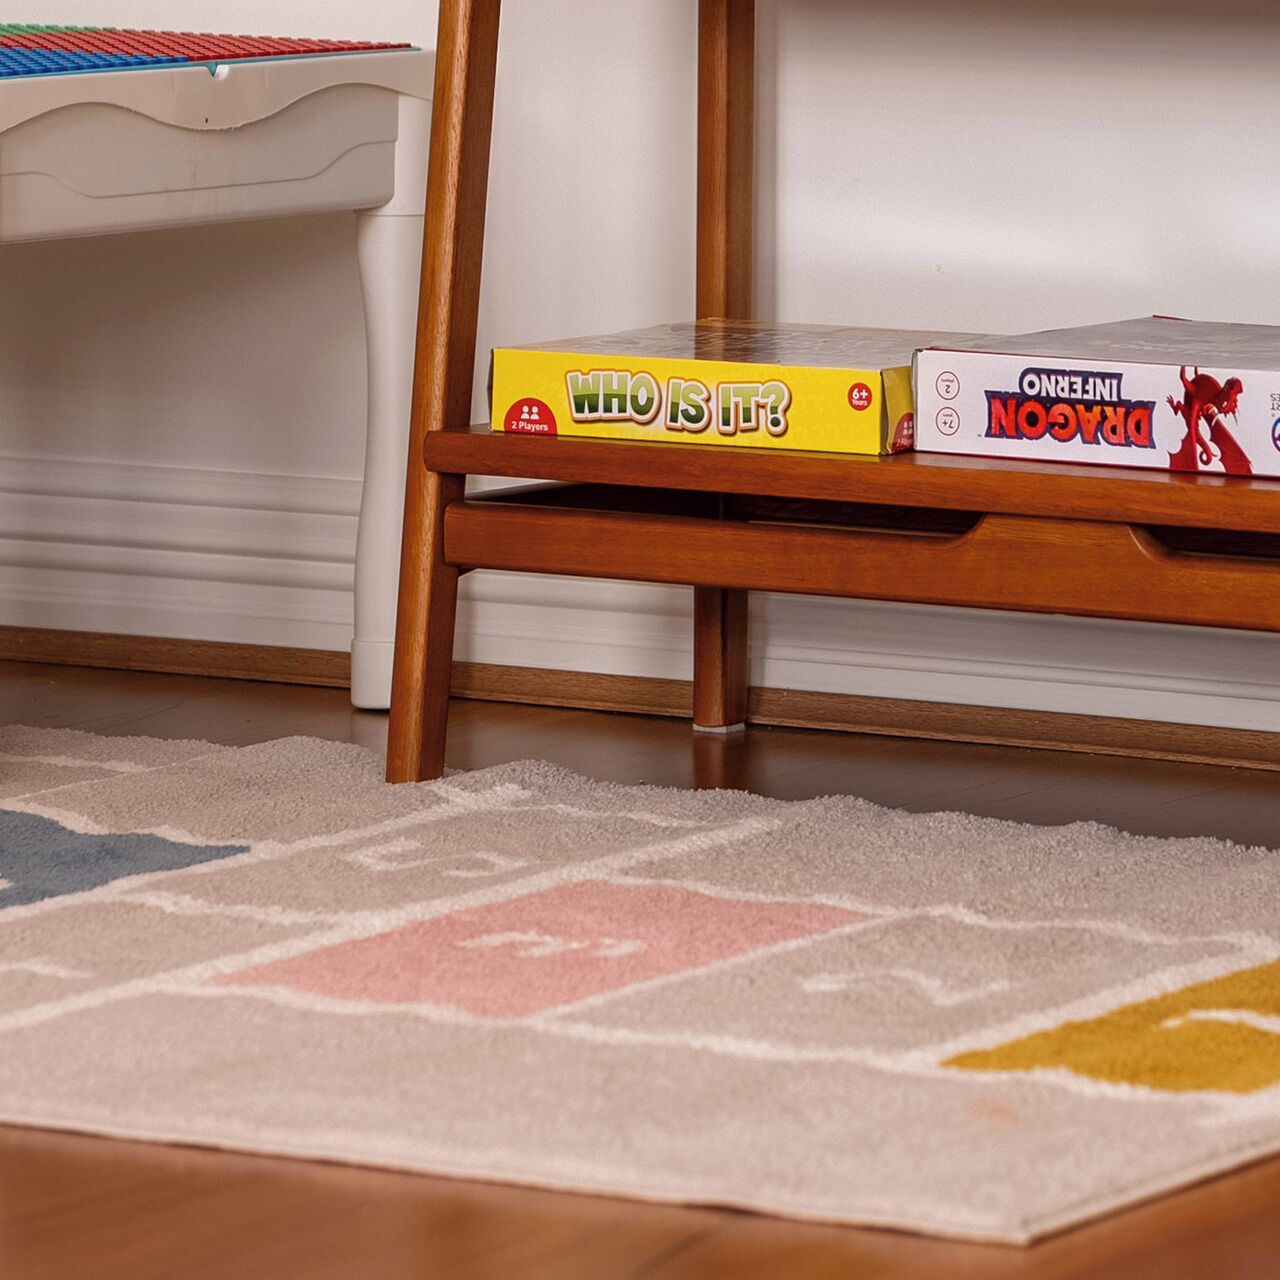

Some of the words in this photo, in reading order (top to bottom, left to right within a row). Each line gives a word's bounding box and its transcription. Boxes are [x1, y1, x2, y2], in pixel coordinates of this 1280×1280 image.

[945, 384, 951, 393] 2
[1023, 373, 1119, 401] INFERNO
[852, 388, 868, 400] 6+
[566, 370, 660, 423] WHO
[666, 378, 710, 432] IS
[717, 381, 792, 436] IT?
[851, 399, 868, 407] Years
[511, 421, 517, 430] 2
[519, 421, 549, 433] Players
[942, 418, 954, 429] 7+
[990, 398, 1151, 446] DRAGON
[450, 926, 648, 962] 3
